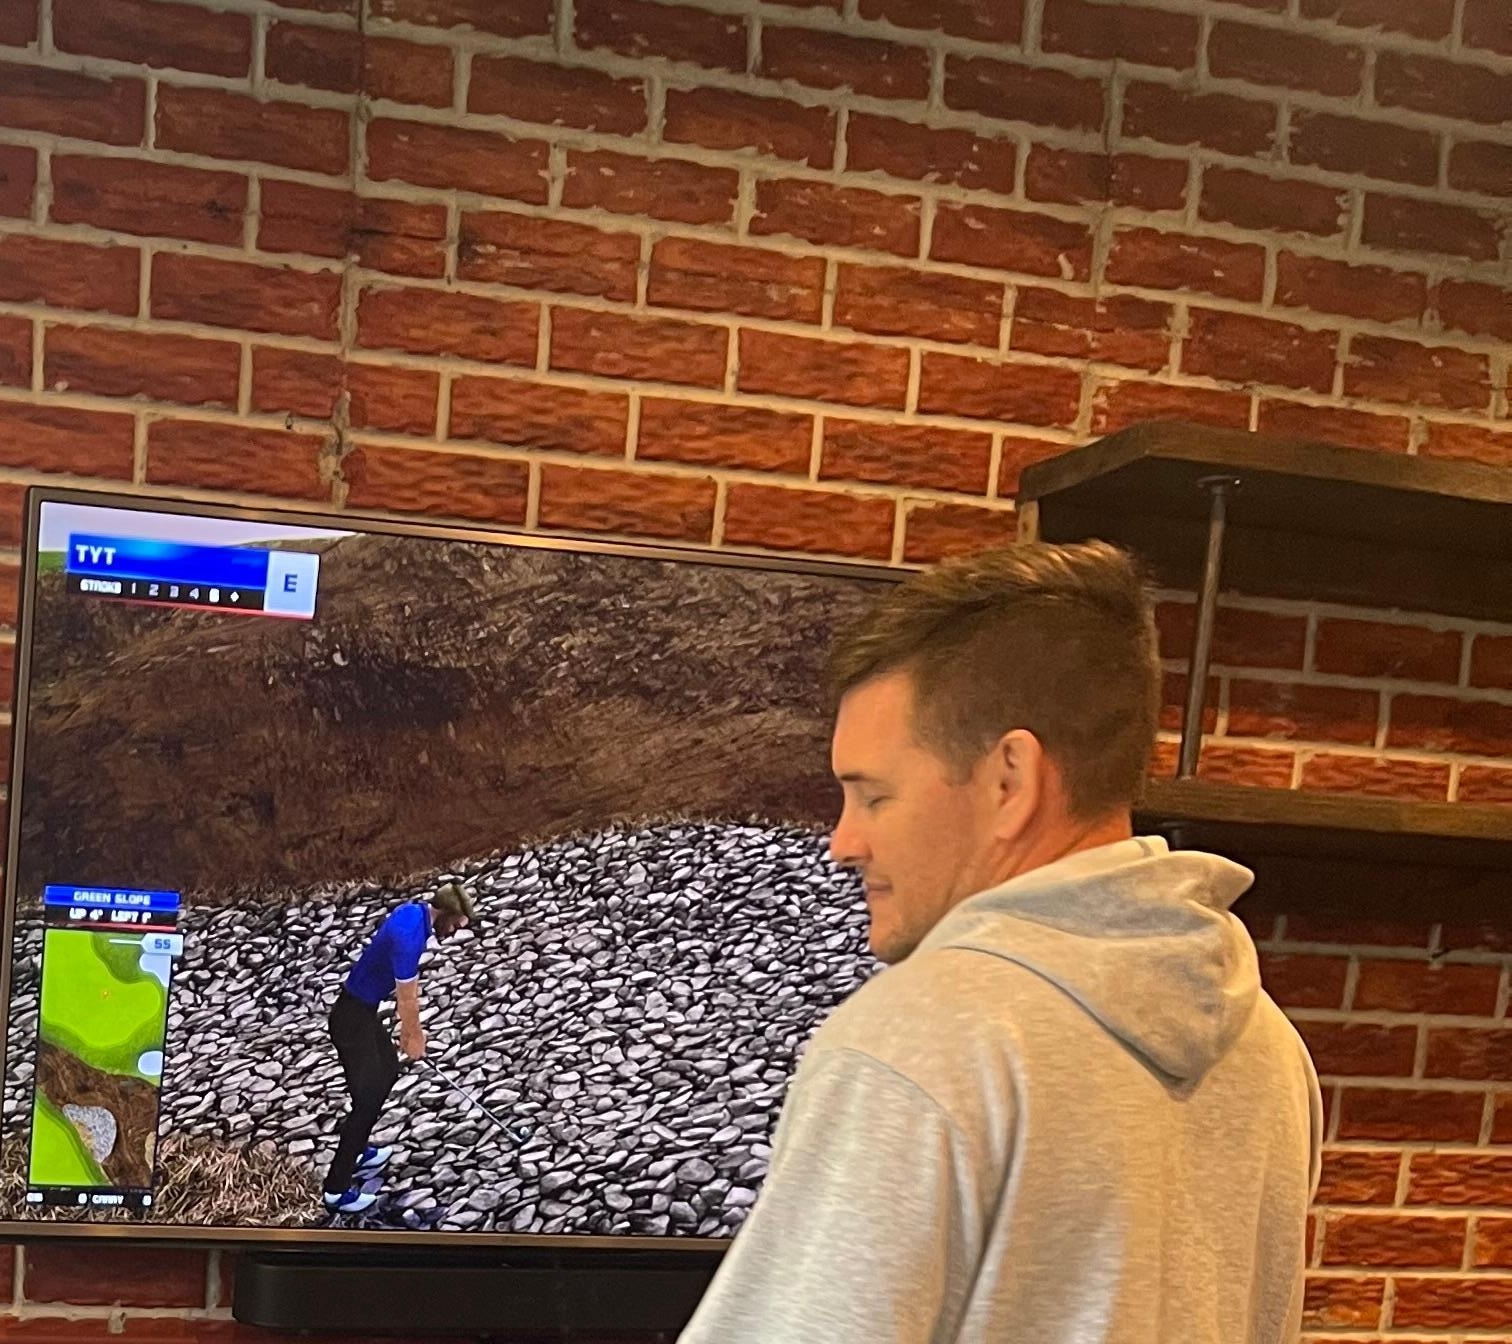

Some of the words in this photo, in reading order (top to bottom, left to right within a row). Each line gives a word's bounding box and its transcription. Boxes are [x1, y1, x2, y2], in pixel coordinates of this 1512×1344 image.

[75, 544, 116, 566] TYT
[284, 573, 298, 593] E
[149, 583, 159, 596] 2
[190, 588, 199, 600] 4
[73, 891, 112, 903] GREEN
[114, 893, 152, 905] SLOPE
